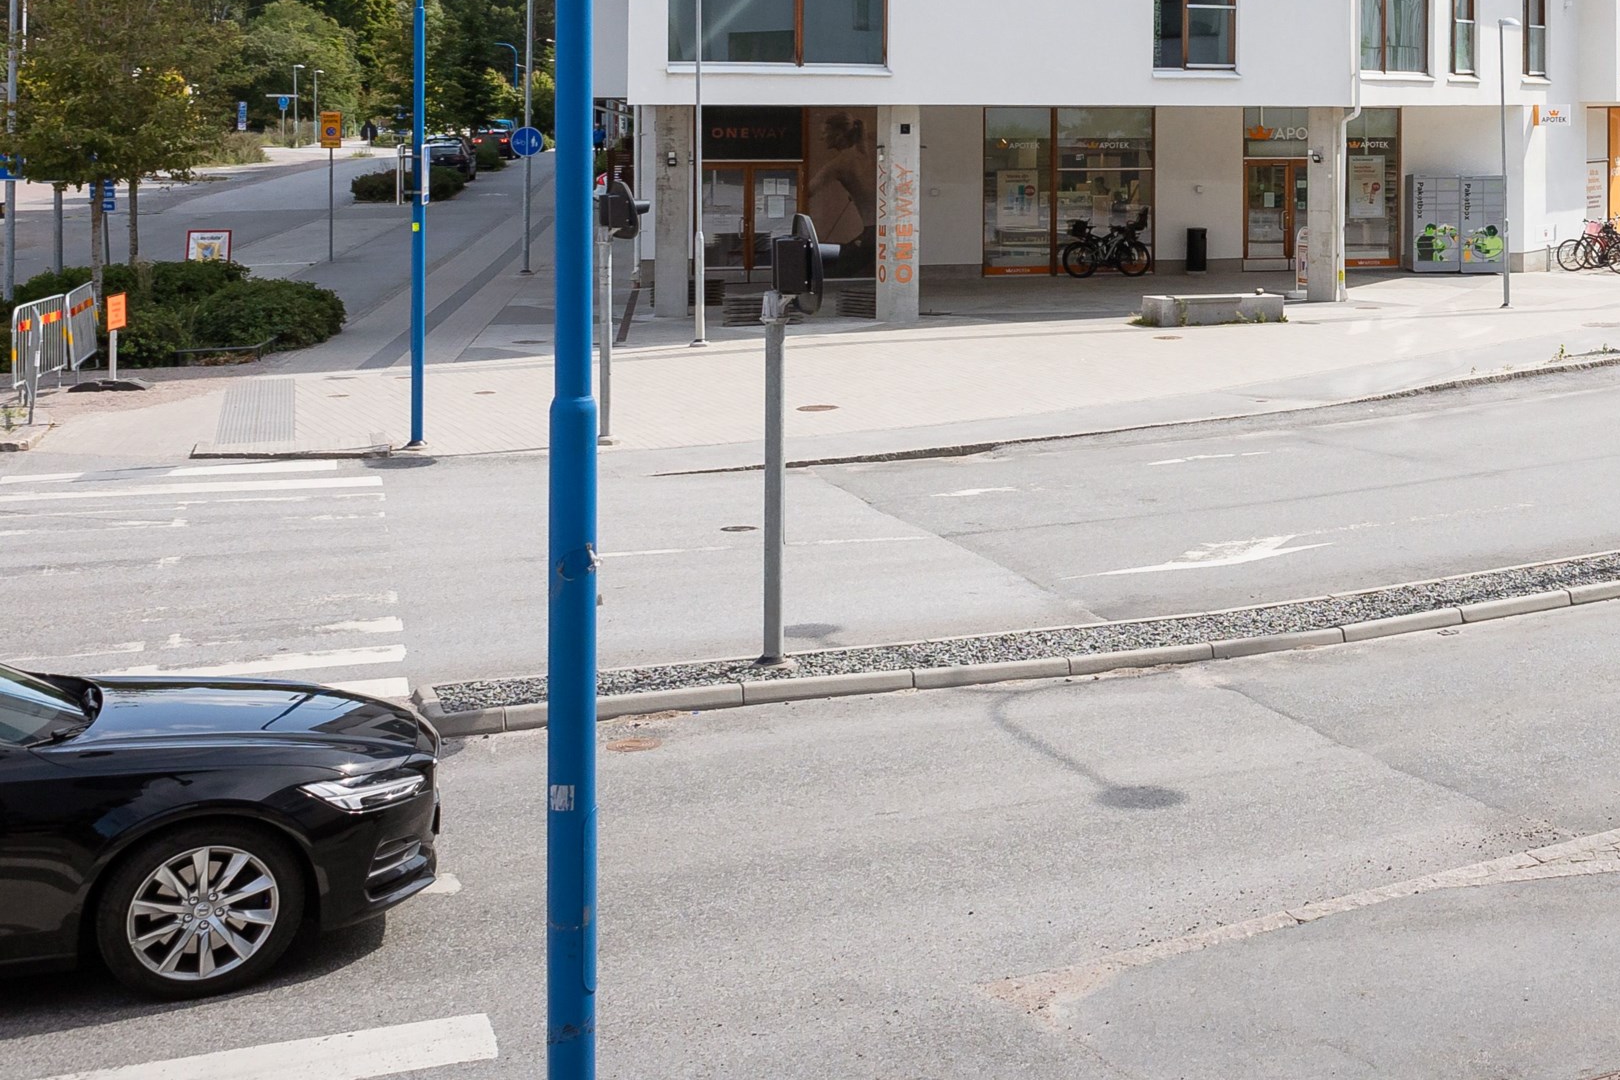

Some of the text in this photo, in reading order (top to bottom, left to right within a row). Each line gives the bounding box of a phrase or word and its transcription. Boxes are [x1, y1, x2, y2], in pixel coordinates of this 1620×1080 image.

[1274, 127, 1308, 140] APO
[1099, 141, 1130, 149] APOTEK
[1360, 141, 1389, 149] APOTEK
